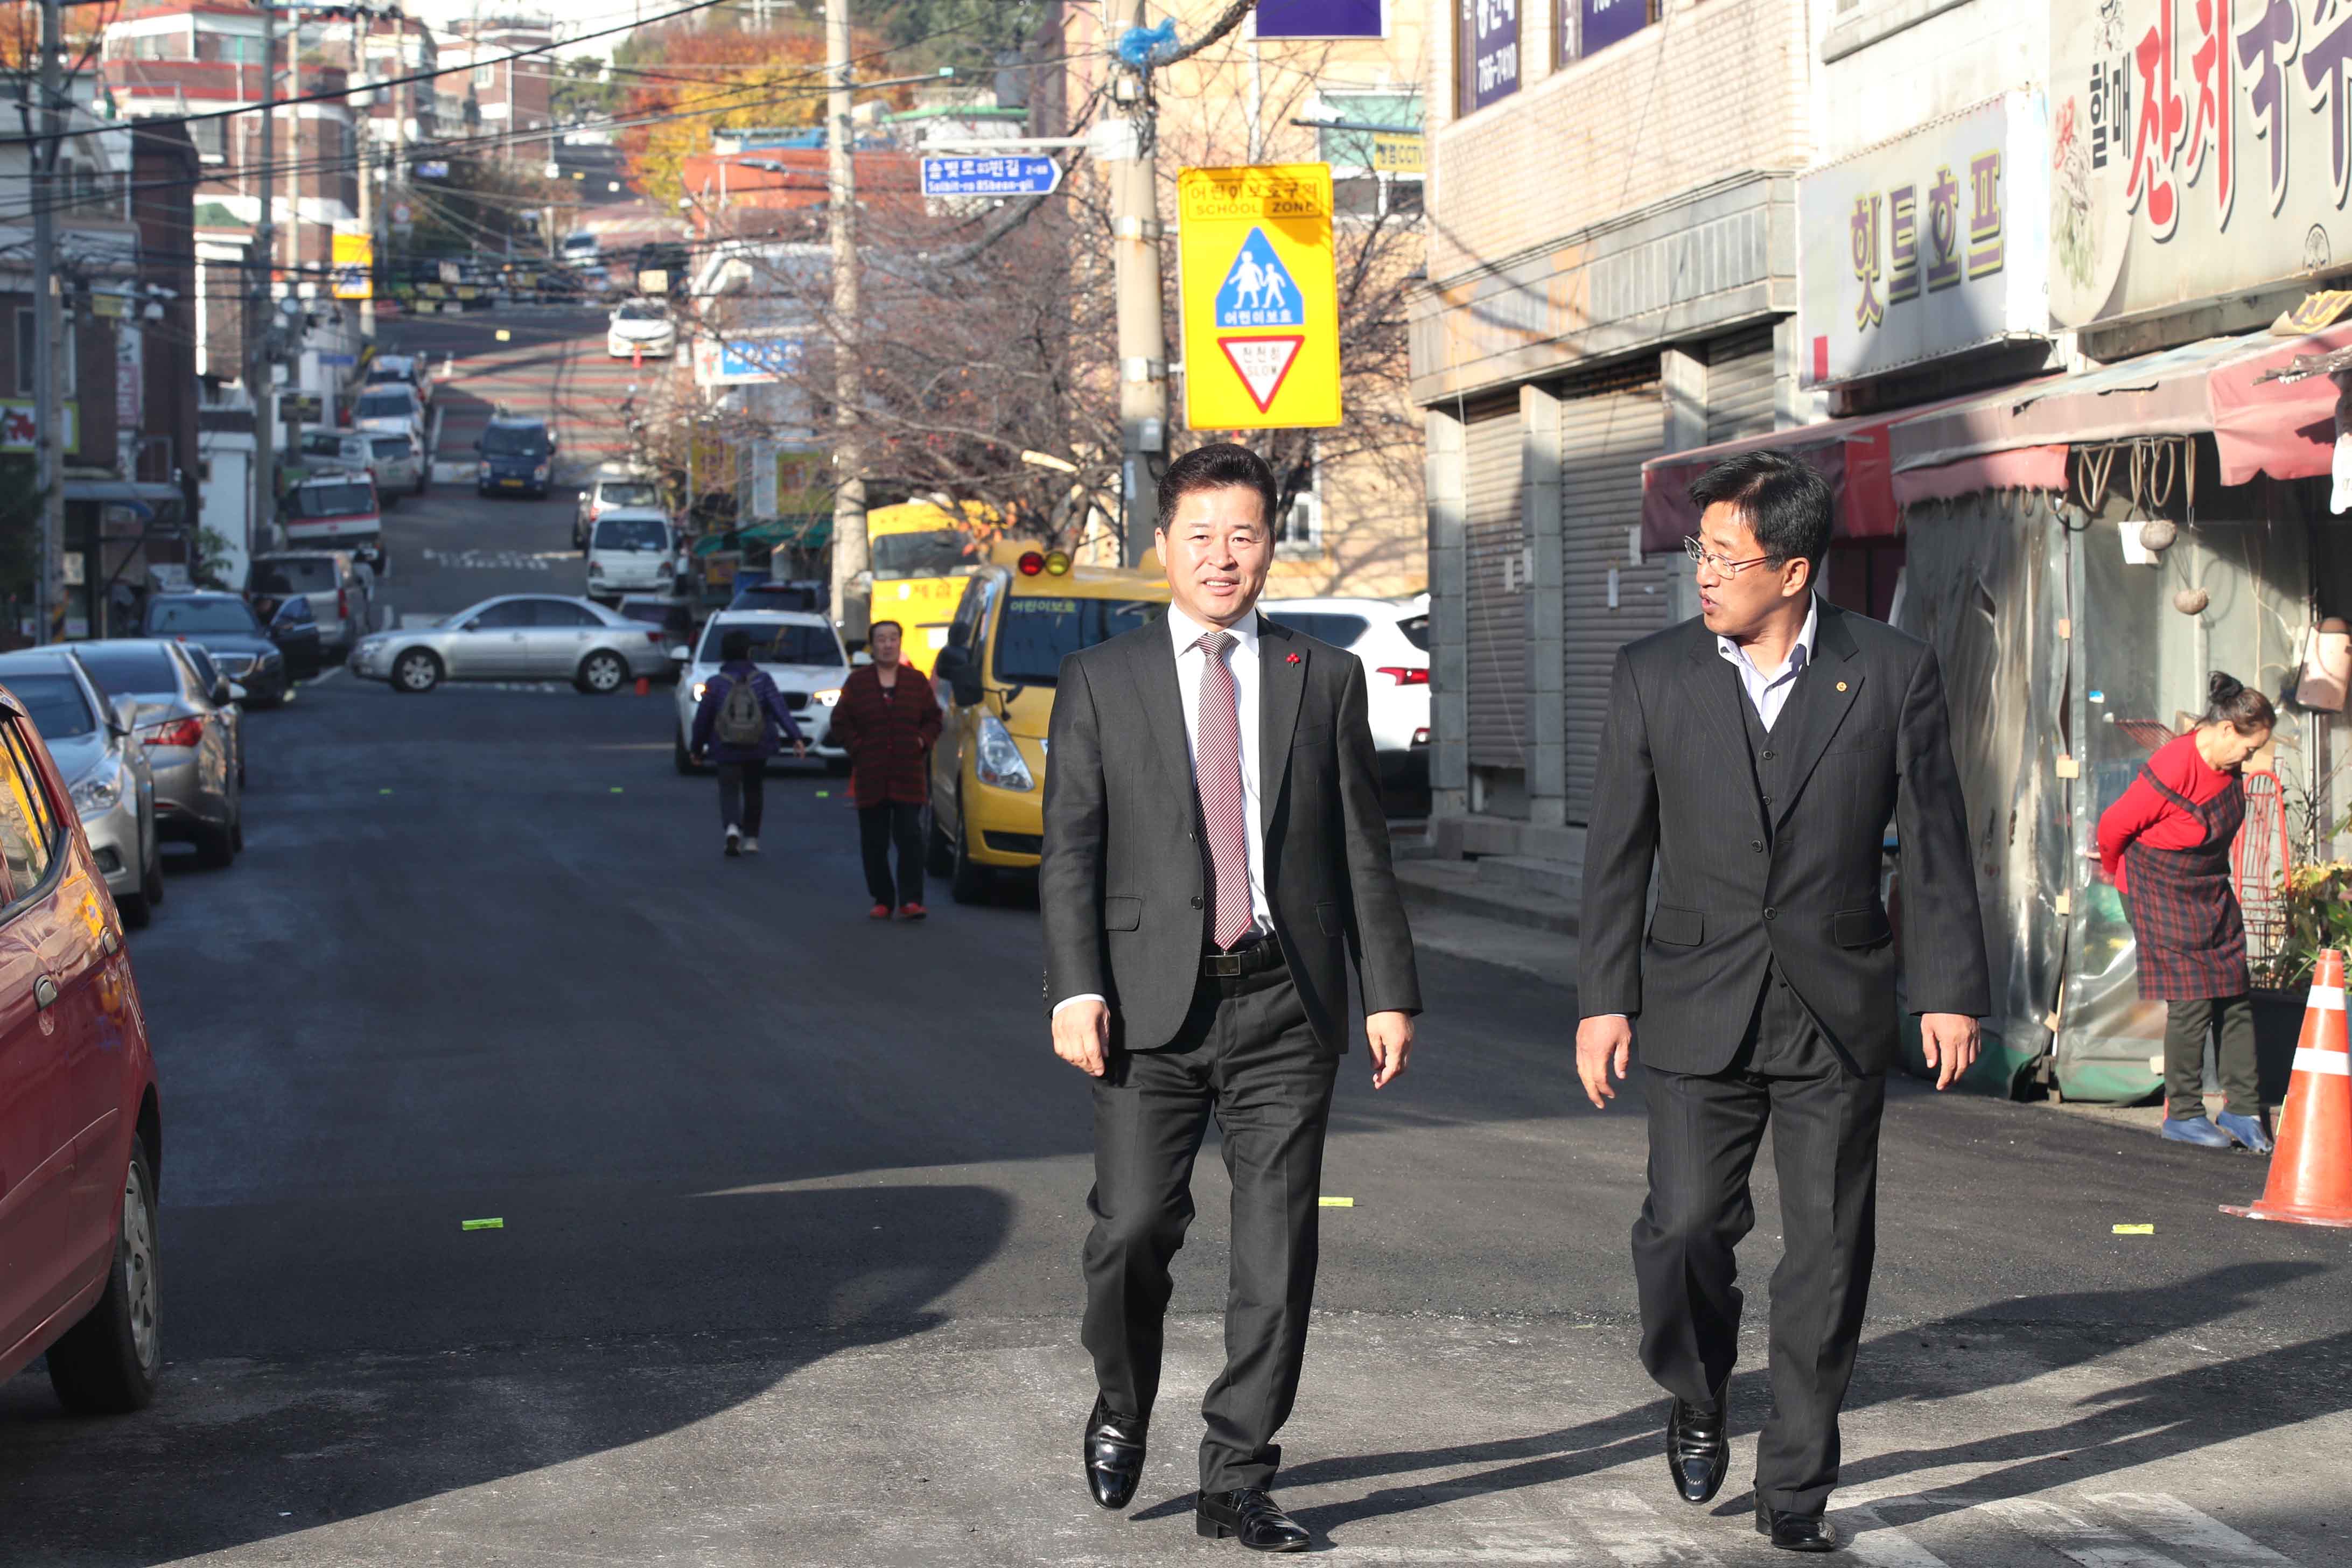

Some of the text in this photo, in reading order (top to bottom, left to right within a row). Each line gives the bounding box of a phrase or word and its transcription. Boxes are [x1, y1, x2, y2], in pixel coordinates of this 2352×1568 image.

[2090, 52, 2131, 170] 할매
[1196, 201, 1315, 215] SCHOOL ZONE
[1850, 148, 2004, 332] 힛트호프
[1223, 309, 1293, 325] 어린이보호
